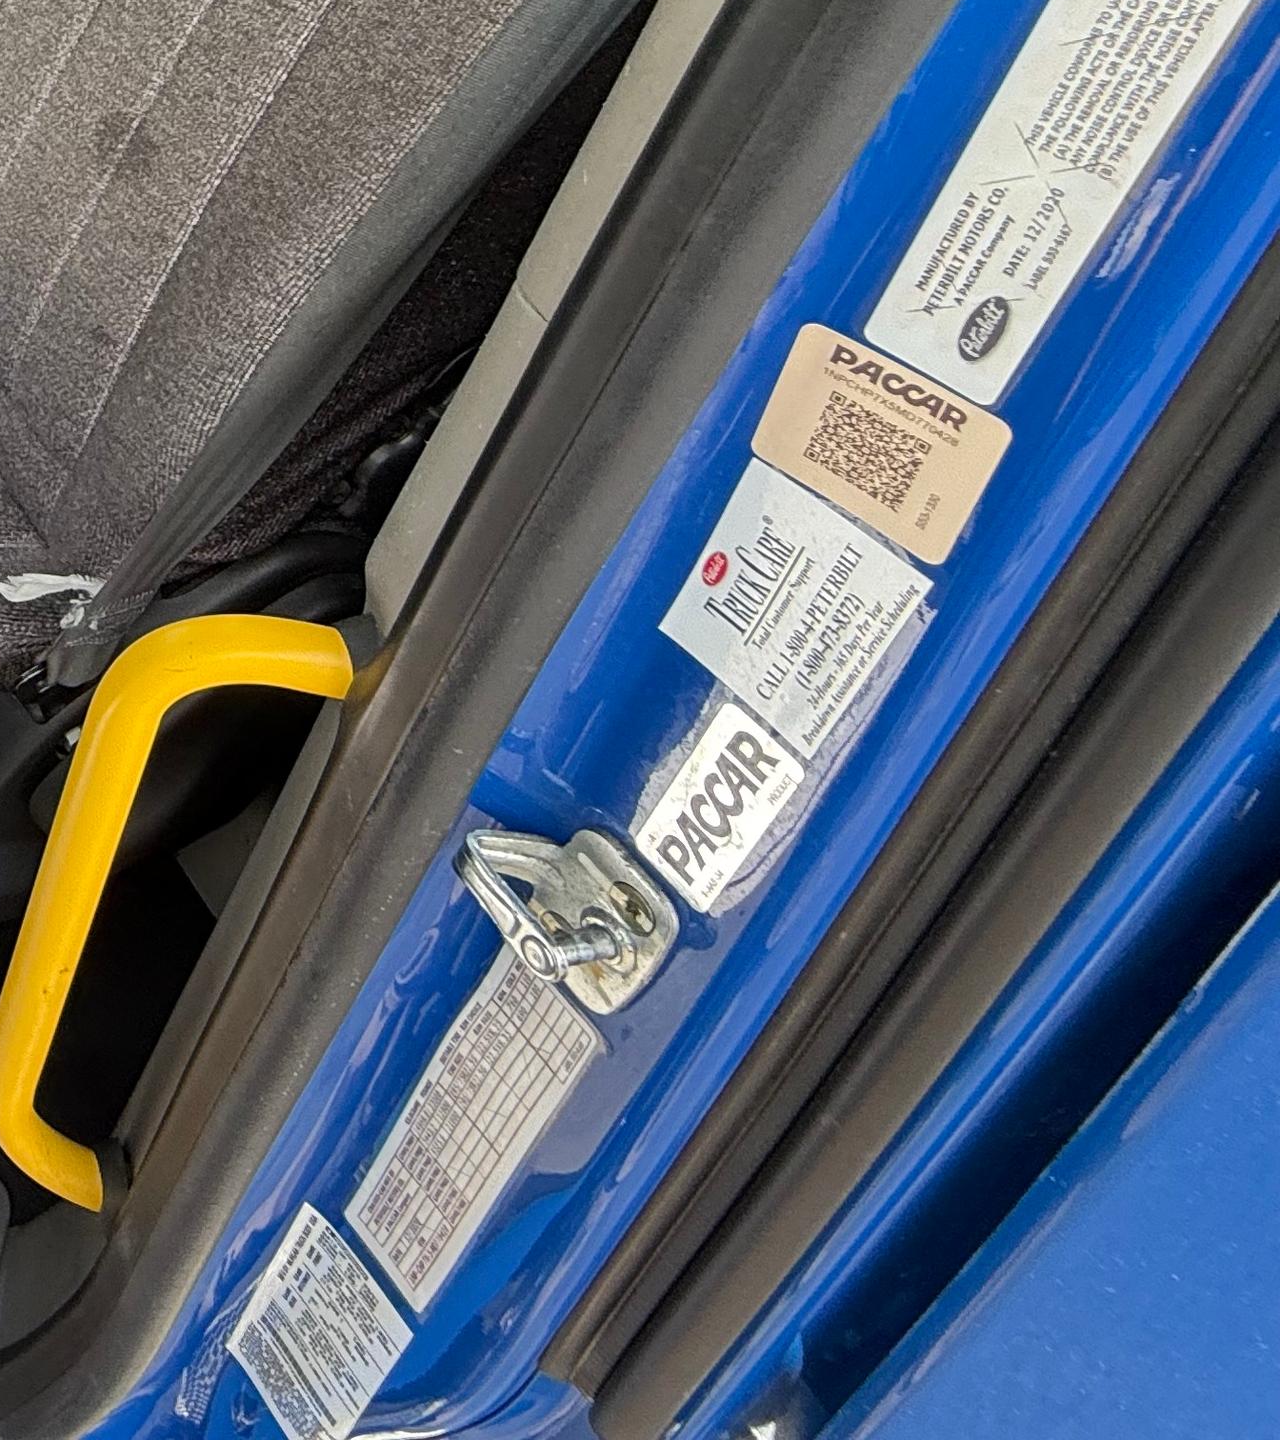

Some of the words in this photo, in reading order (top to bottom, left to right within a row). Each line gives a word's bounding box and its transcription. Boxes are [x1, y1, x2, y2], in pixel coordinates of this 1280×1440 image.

[1022, 123, 1045, 146] THIS
[1037, 81, 1070, 122] VEHICLE
[1062, 25, 1103, 82] CONFORMS
[1094, 10, 1112, 25] TO
[1037, 133, 1058, 153] THE
[1049, 75, 1093, 134] FOLLOWING
[1085, 48, 1110, 77] ACTS
[1102, 31, 1120, 48] OR
[1111, 9, 1134, 31] THE
[1051, 143, 1072, 161] (A)
[1062, 122, 1083, 142] THE
[1075, 78, 1112, 123] REMOVAL
[1104, 60, 1122, 76] OR
[1114, 0, 1159, 60] RENDERING
[1068, 144, 1087, 166] ANY
[1080, 113, 1108, 147] NOISE
[1100, 68, 1138, 114] CONTROL
[1129, 28, 1162, 67] DEVICE
[1154, 11, 1172, 28] OR
[1082, 111, 1129, 174] COMPLIANCE
[1120, 83, 1147, 111] WITH
[1138, 60, 1161, 82] THE
[1152, 27, 1182, 62] NOISE
[1096, 161, 1117, 181] (B)
[1107, 142, 1129, 163] THE
[1121, 120, 1143, 142] USE
[1134, 104, 1150, 121] OF
[1143, 78, 1169, 105] THIS
[1161, 35, 1197, 79] VEHICLE
[1189, 2, 1218, 37] AFTER
[914, 208, 970, 292] MANUFACTURED
[962, 191, 979, 209] BY
[921, 254, 965, 317] PETERBILT
[957, 206, 995, 256] MOTORS
[986, 186, 1009, 206] CO.
[957, 258, 987, 296] PACCAR
[980, 213, 1015, 259] Company
[1001, 244, 1031, 278] DATE:
[1024, 264, 1049, 291] LABEL
[952, 296, 964, 306] A
[828, 343, 968, 432] PACCAR
[750, 625, 772, 650] Total
[764, 590, 795, 629] Customer
[788, 556, 816, 592] Support
[755, 661, 790, 701] CALL
[778, 541, 863, 666] 1-800-4-PETERBILT
[794, 592, 865, 691] (1-800-473-8372)
[805, 672, 837, 710] 24-Hours
[831, 649, 849, 671] 365
[841, 633, 862, 656] Days
[854, 618, 872, 636] Per
[864, 600, 884, 621] Year
[800, 702, 836, 746] Breakdown
[830, 664, 862, 704] Assistance
[860, 627, 890, 659] Service
[880, 583, 920, 630] Scheduling
[654, 730, 781, 887] PACCAR
